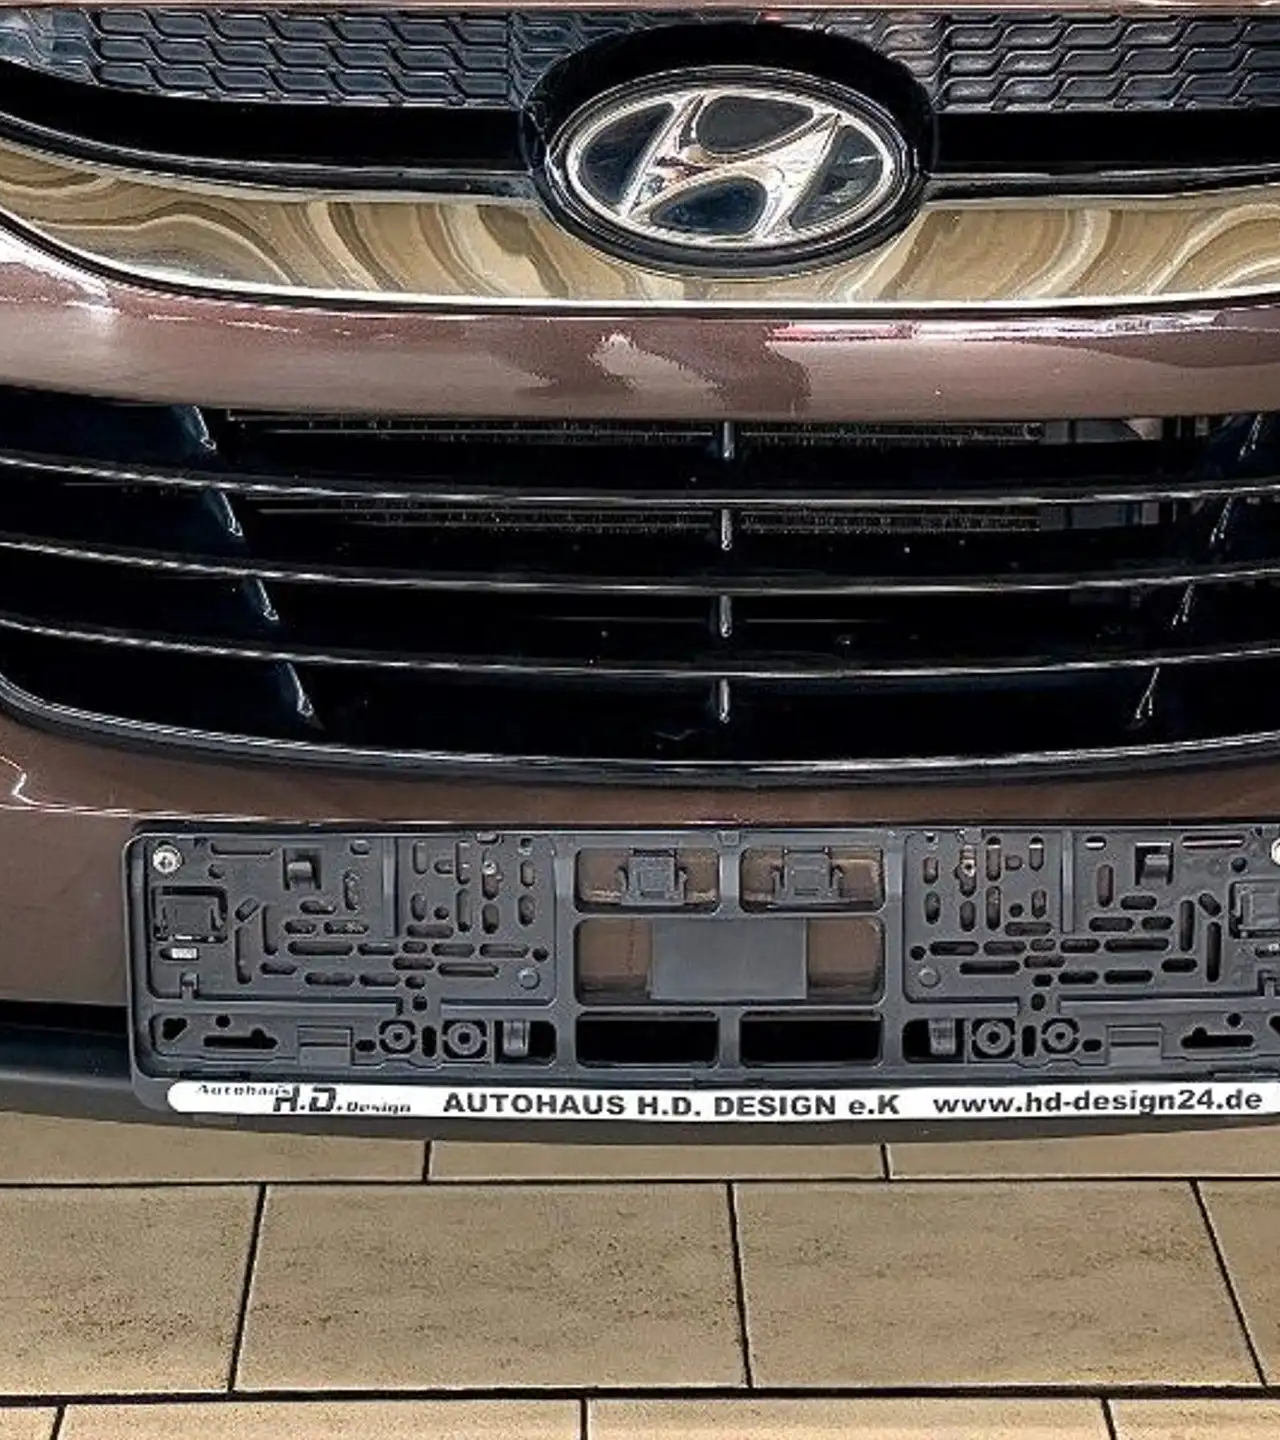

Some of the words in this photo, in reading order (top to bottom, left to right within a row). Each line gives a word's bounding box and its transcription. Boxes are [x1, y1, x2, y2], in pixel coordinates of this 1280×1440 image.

[443, 1091, 625, 1116] AUTOHAUS
[637, 1094, 702, 1117] H.D.
[714, 1094, 836, 1117] DESIGN
[847, 1093, 901, 1116] e.K
[933, 1087, 1264, 1116] www.hd-design24.de
